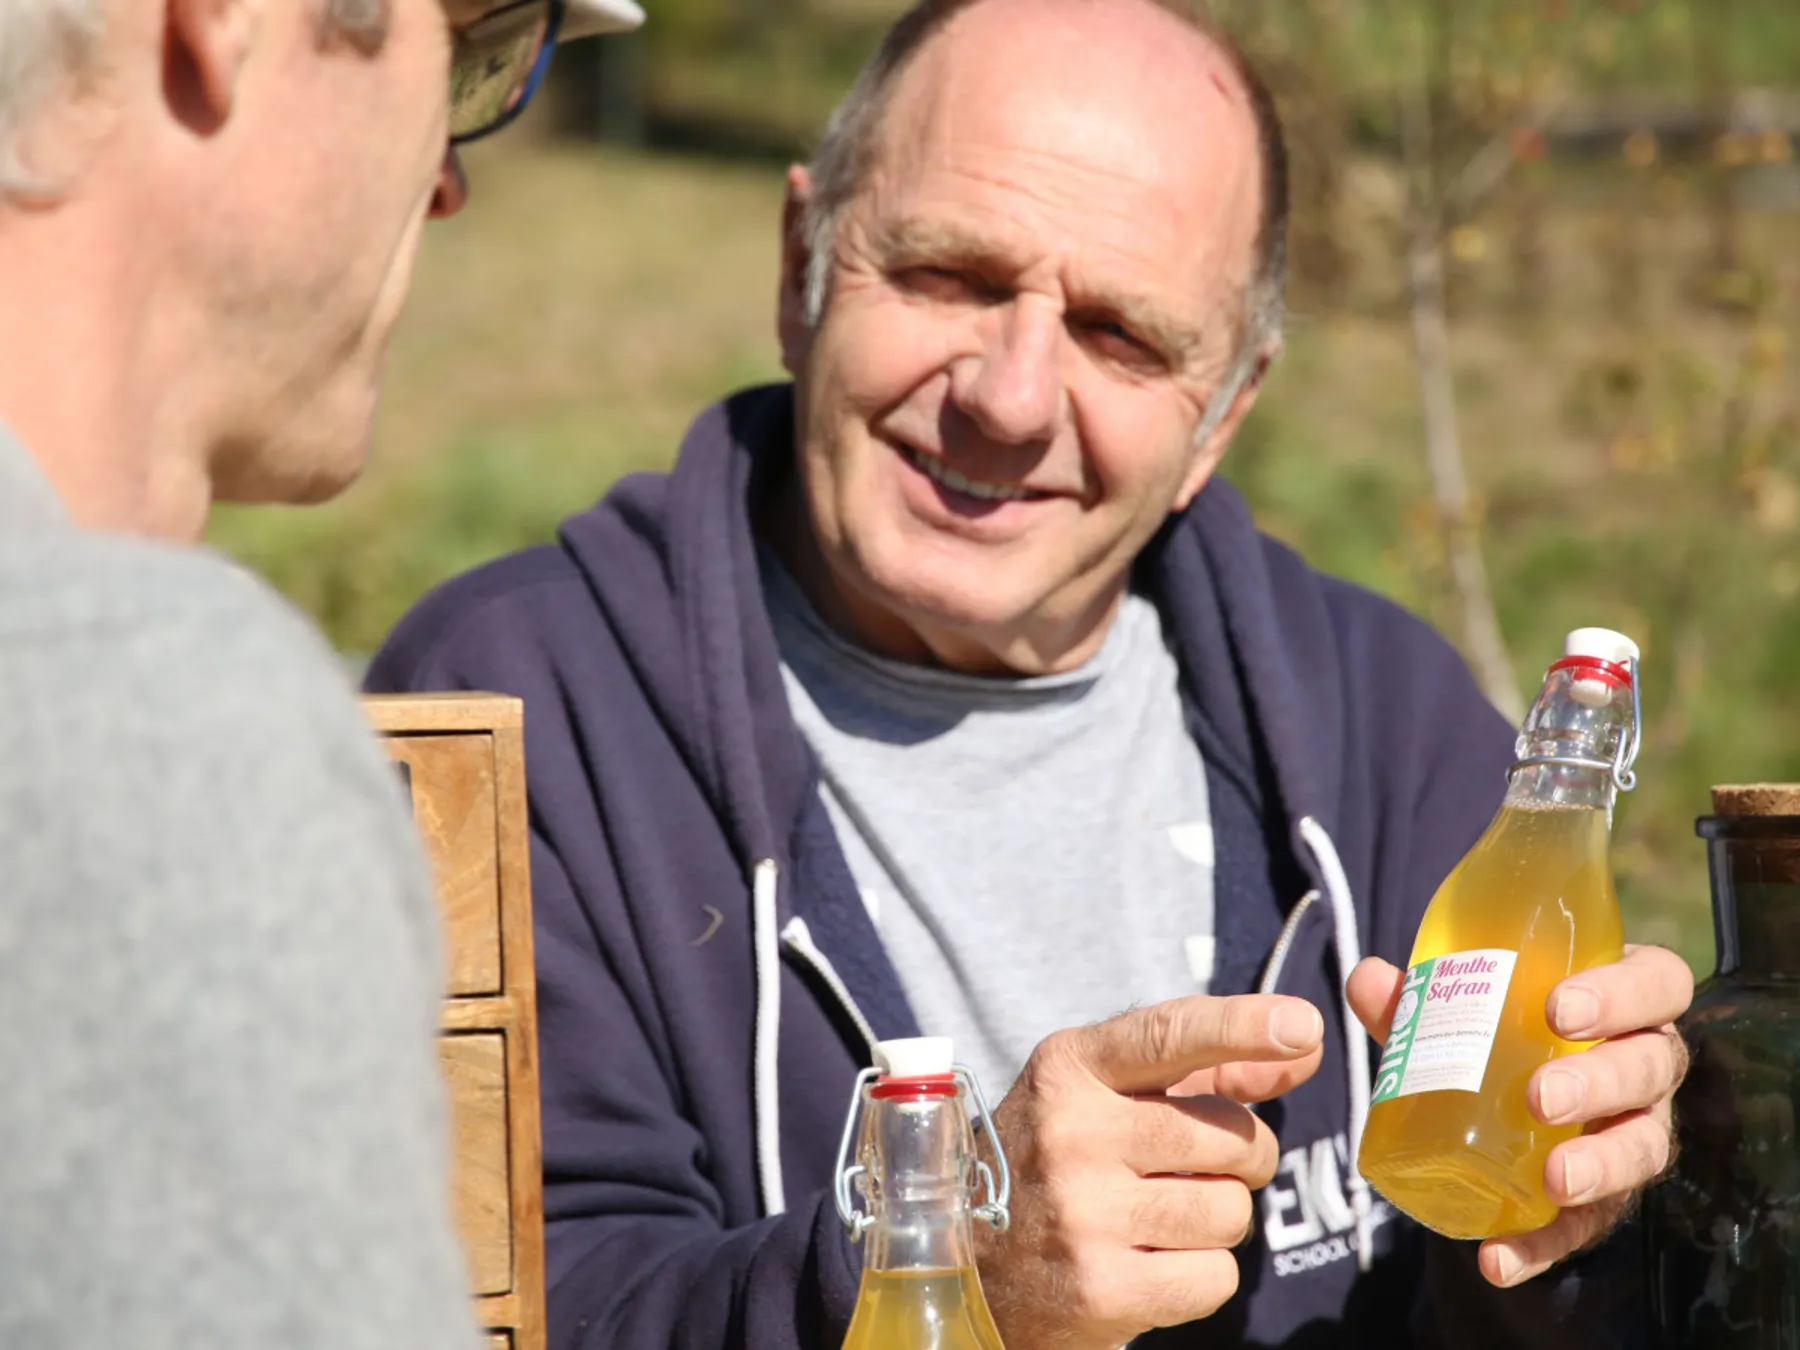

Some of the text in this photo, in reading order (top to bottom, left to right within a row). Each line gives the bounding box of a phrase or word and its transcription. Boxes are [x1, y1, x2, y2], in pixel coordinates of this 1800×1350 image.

[1435, 956, 1498, 979] Menthe
[1426, 979, 1491, 1002] Safran
[1273, 1236, 1349, 1277] SCHOOL
